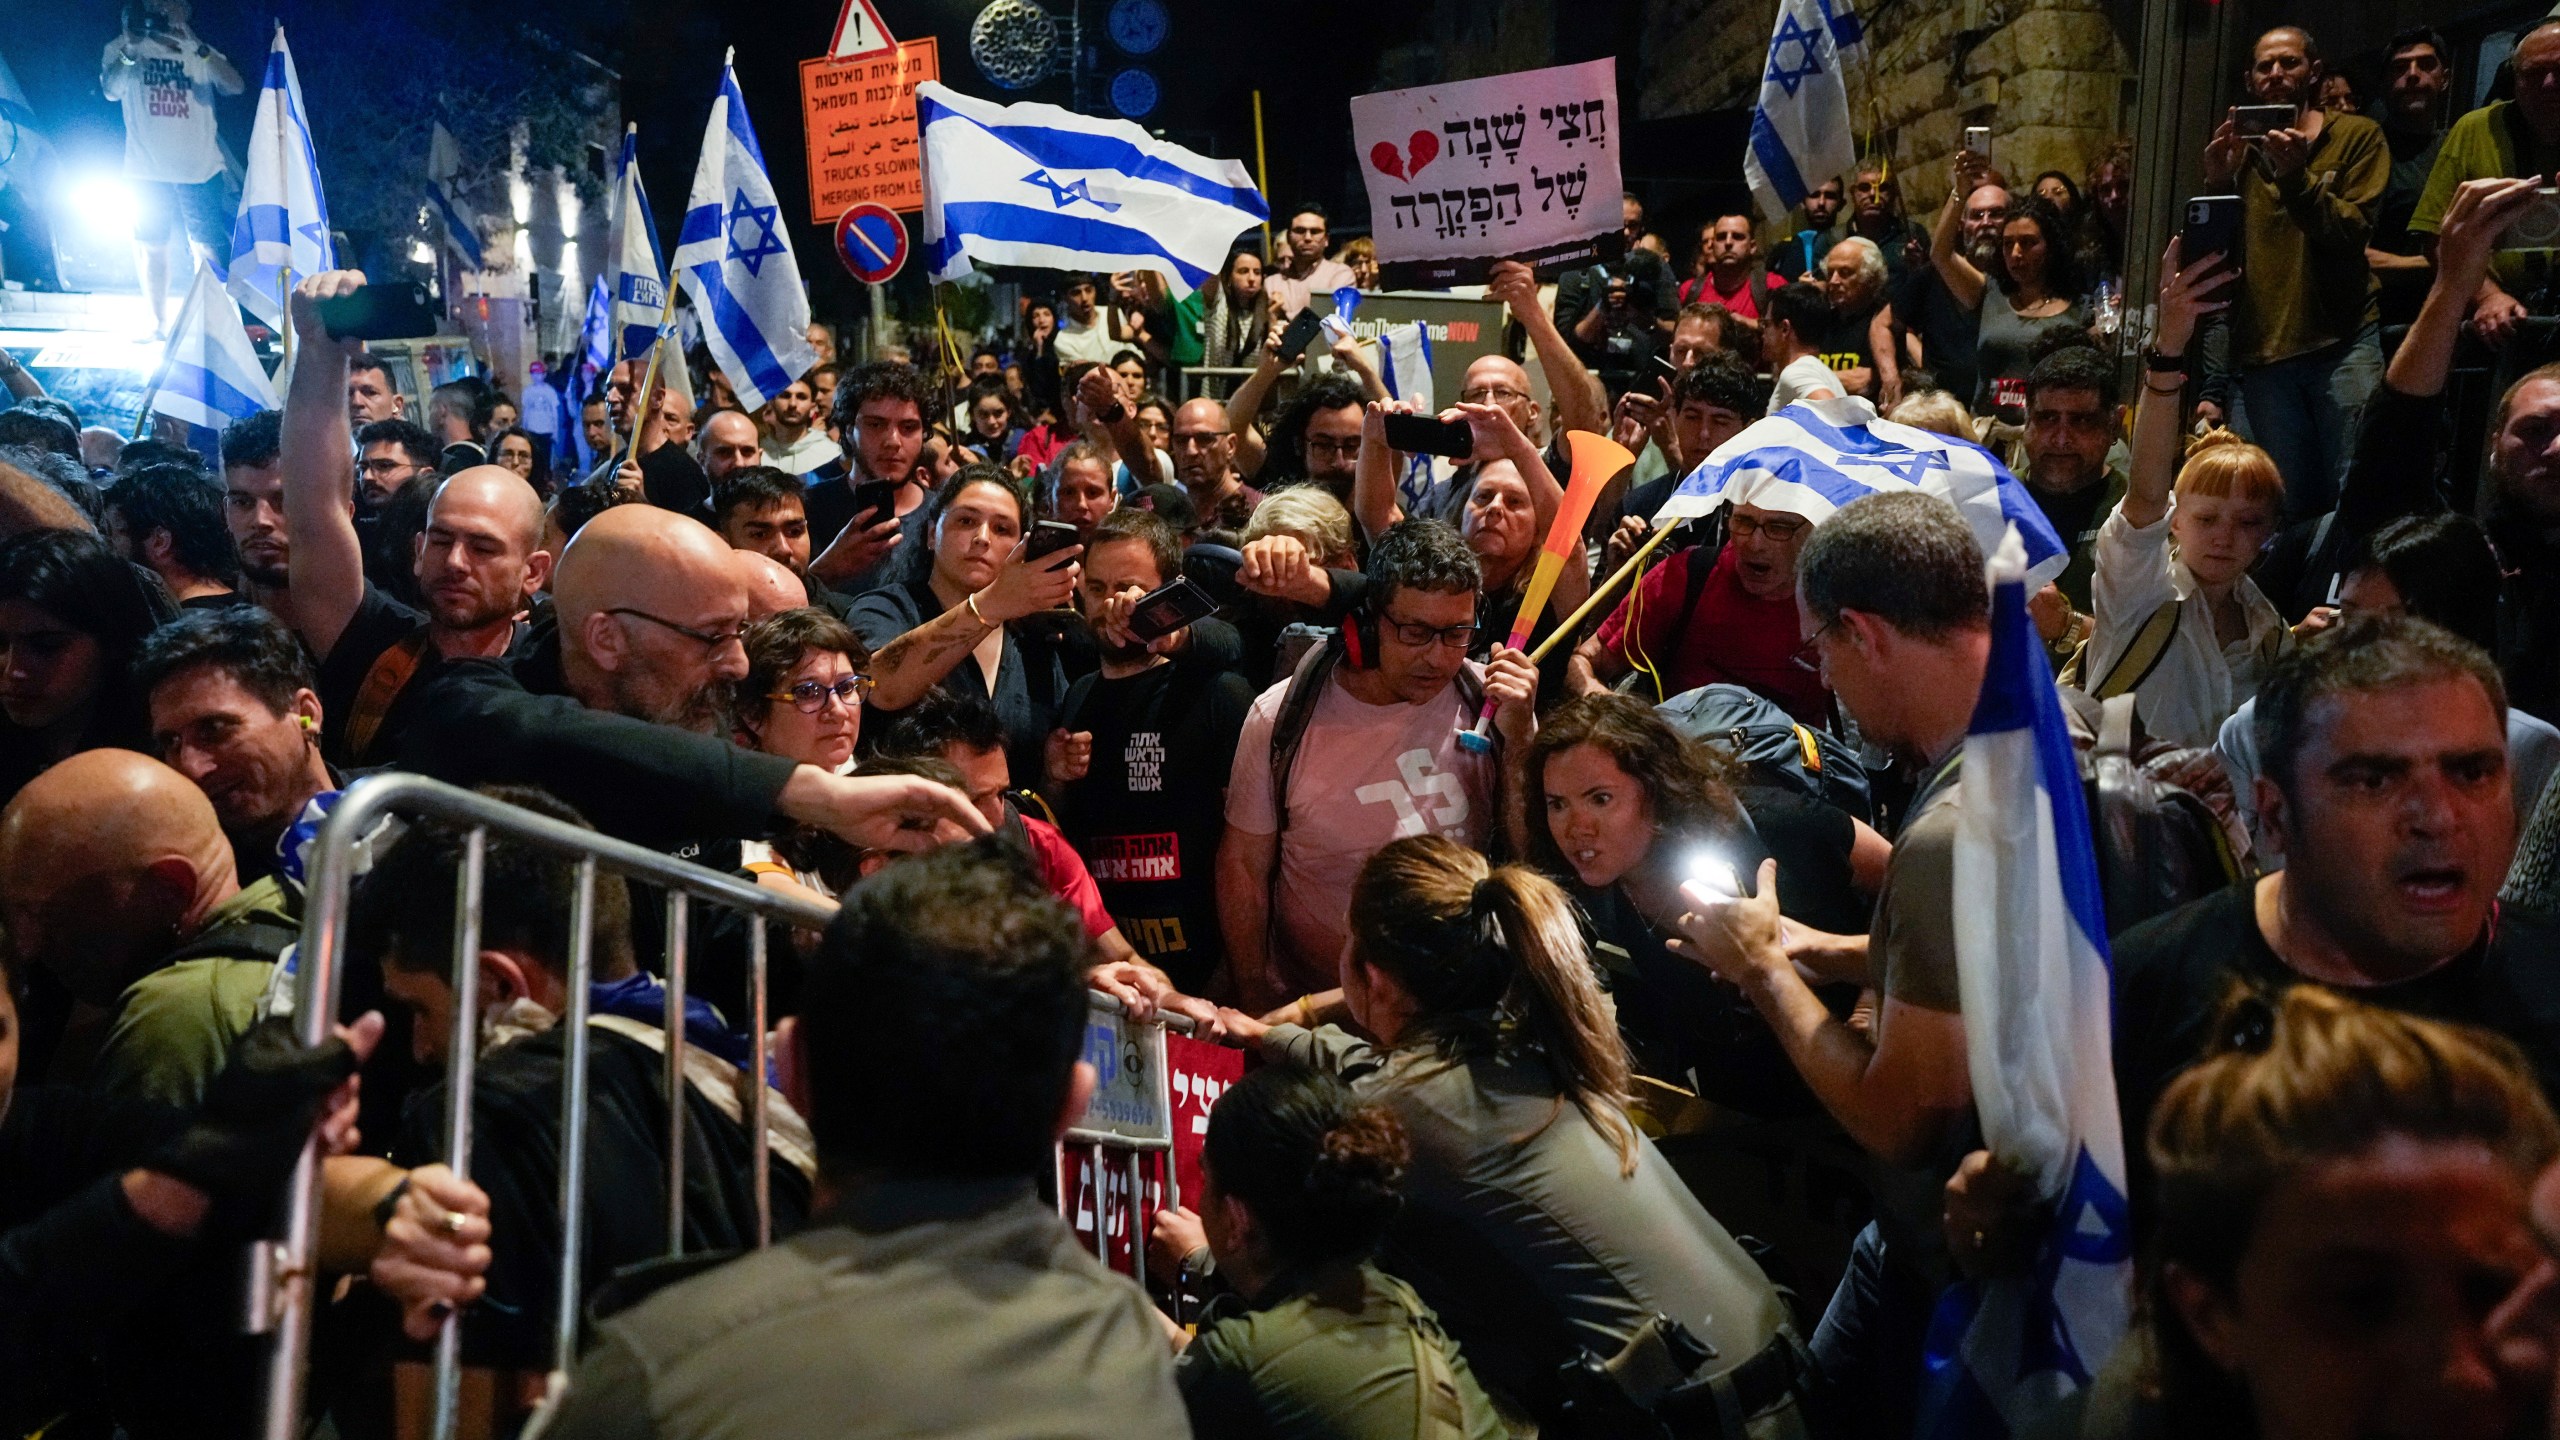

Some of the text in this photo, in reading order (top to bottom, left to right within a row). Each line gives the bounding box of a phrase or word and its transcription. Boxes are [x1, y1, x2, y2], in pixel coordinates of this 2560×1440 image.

[815, 68, 863, 89] מאיטות
[150, 88, 188, 103] אתה
[812, 81, 918, 111] שתלבות משמאל
[149, 102, 189, 119] אשם
[824, 158, 920, 184] TRUCKS SLOWIN
[822, 180, 922, 206] MERGING FROM LE
[1130, 732, 1161, 748] אתה
[1124, 747, 1166, 763] הראש
[1128, 762, 1160, 777] אתה
[1127, 777, 1162, 791] אשם
[1130, 835, 1173, 858] אתה
[1131, 856, 1175, 879] אתה
[1173, 1068, 1233, 1135] צי
